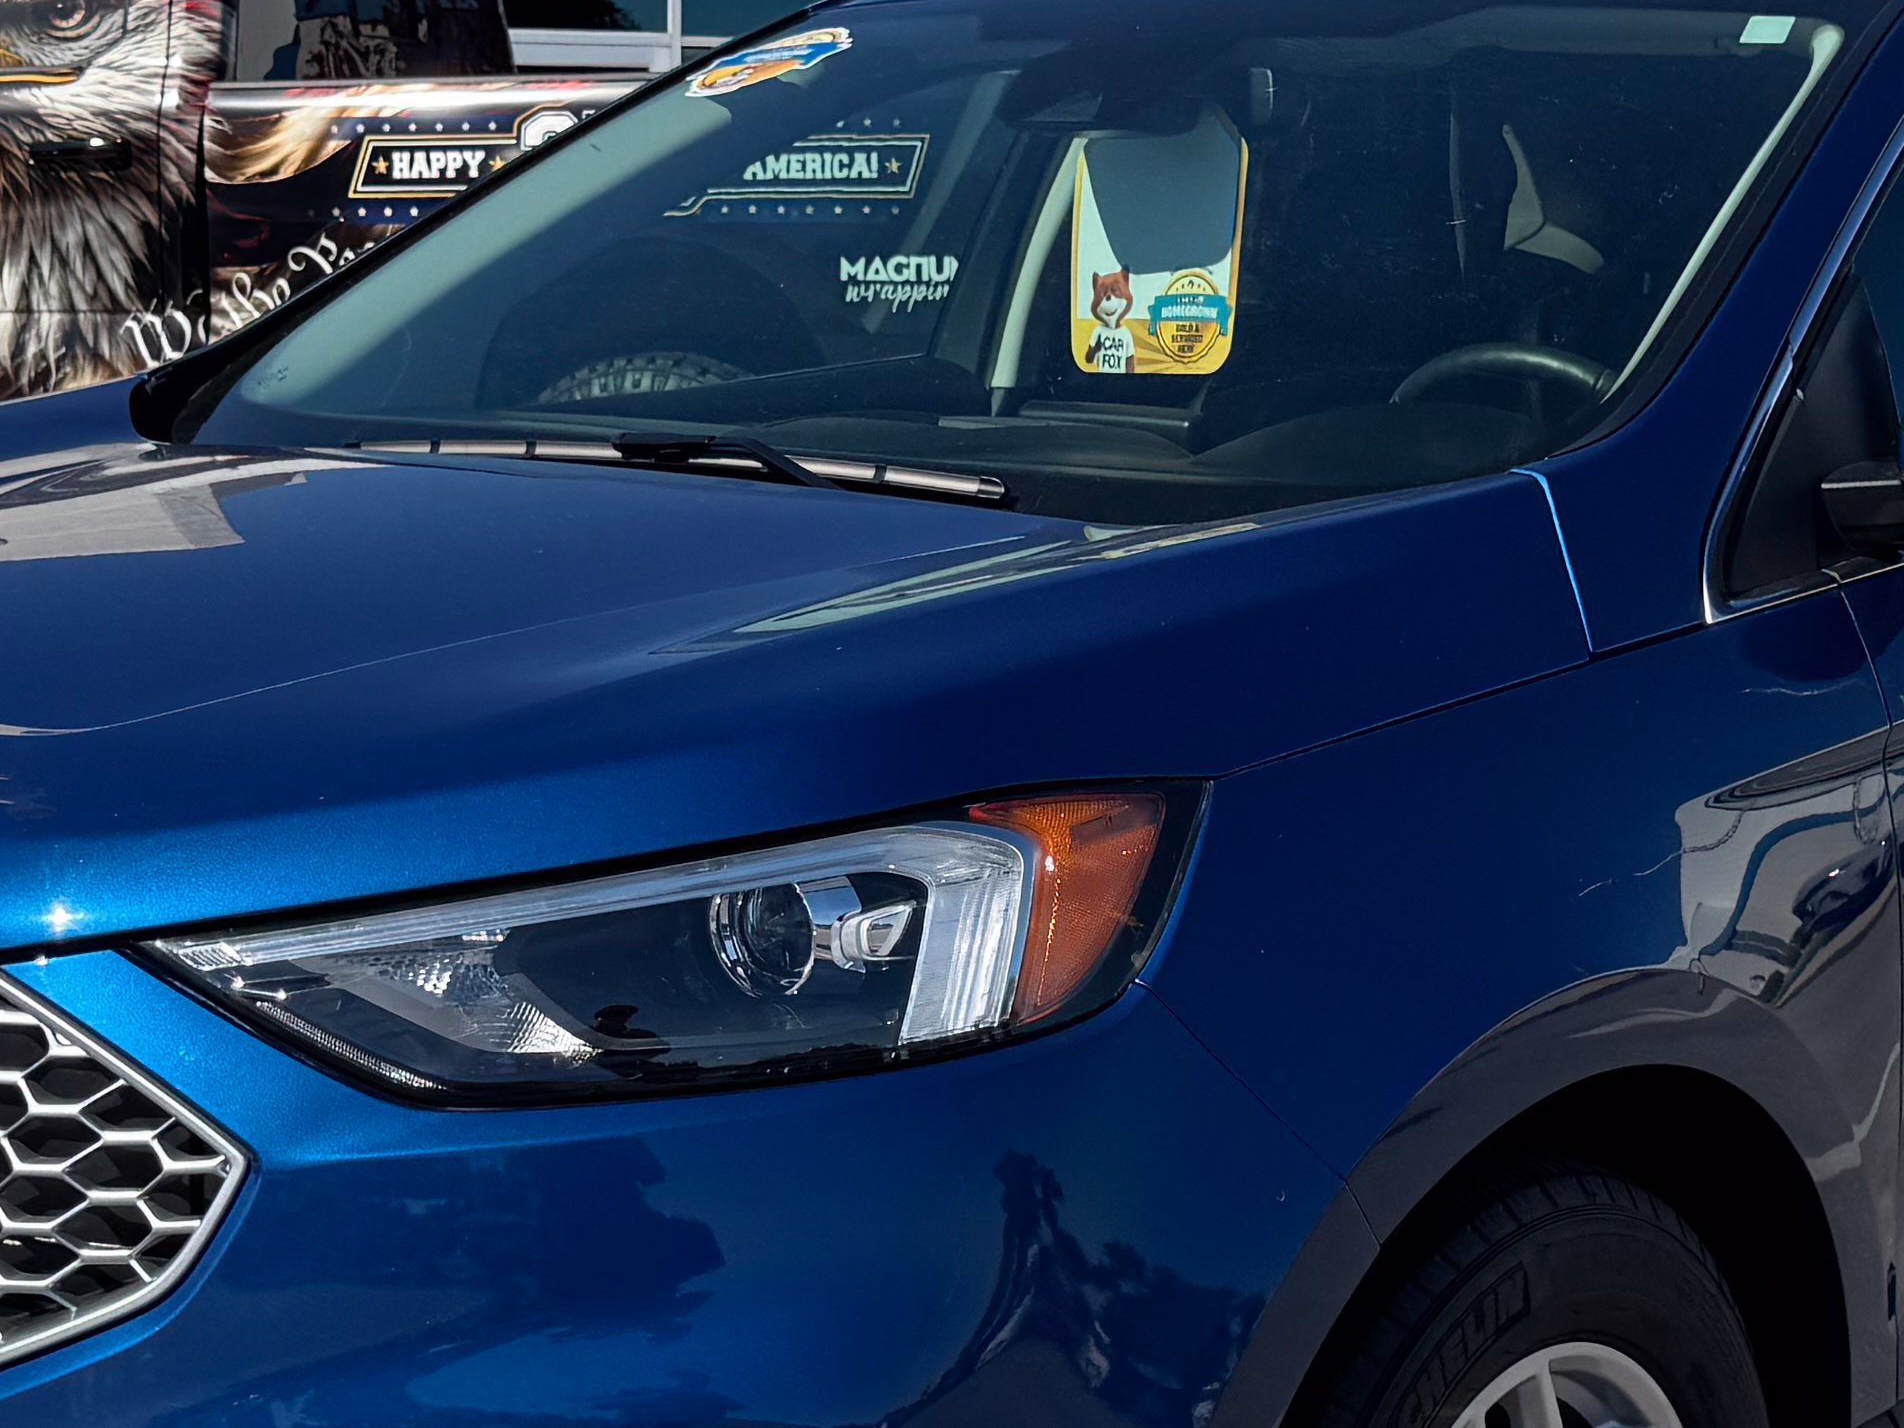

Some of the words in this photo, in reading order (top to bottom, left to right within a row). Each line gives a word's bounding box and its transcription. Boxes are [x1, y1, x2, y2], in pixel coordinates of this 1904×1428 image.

[391, 150, 486, 180] HAPPY
[743, 151, 879, 181] AMERICA!
[1102, 336, 1124, 351] CAR
[1102, 354, 1122, 369] FOX
